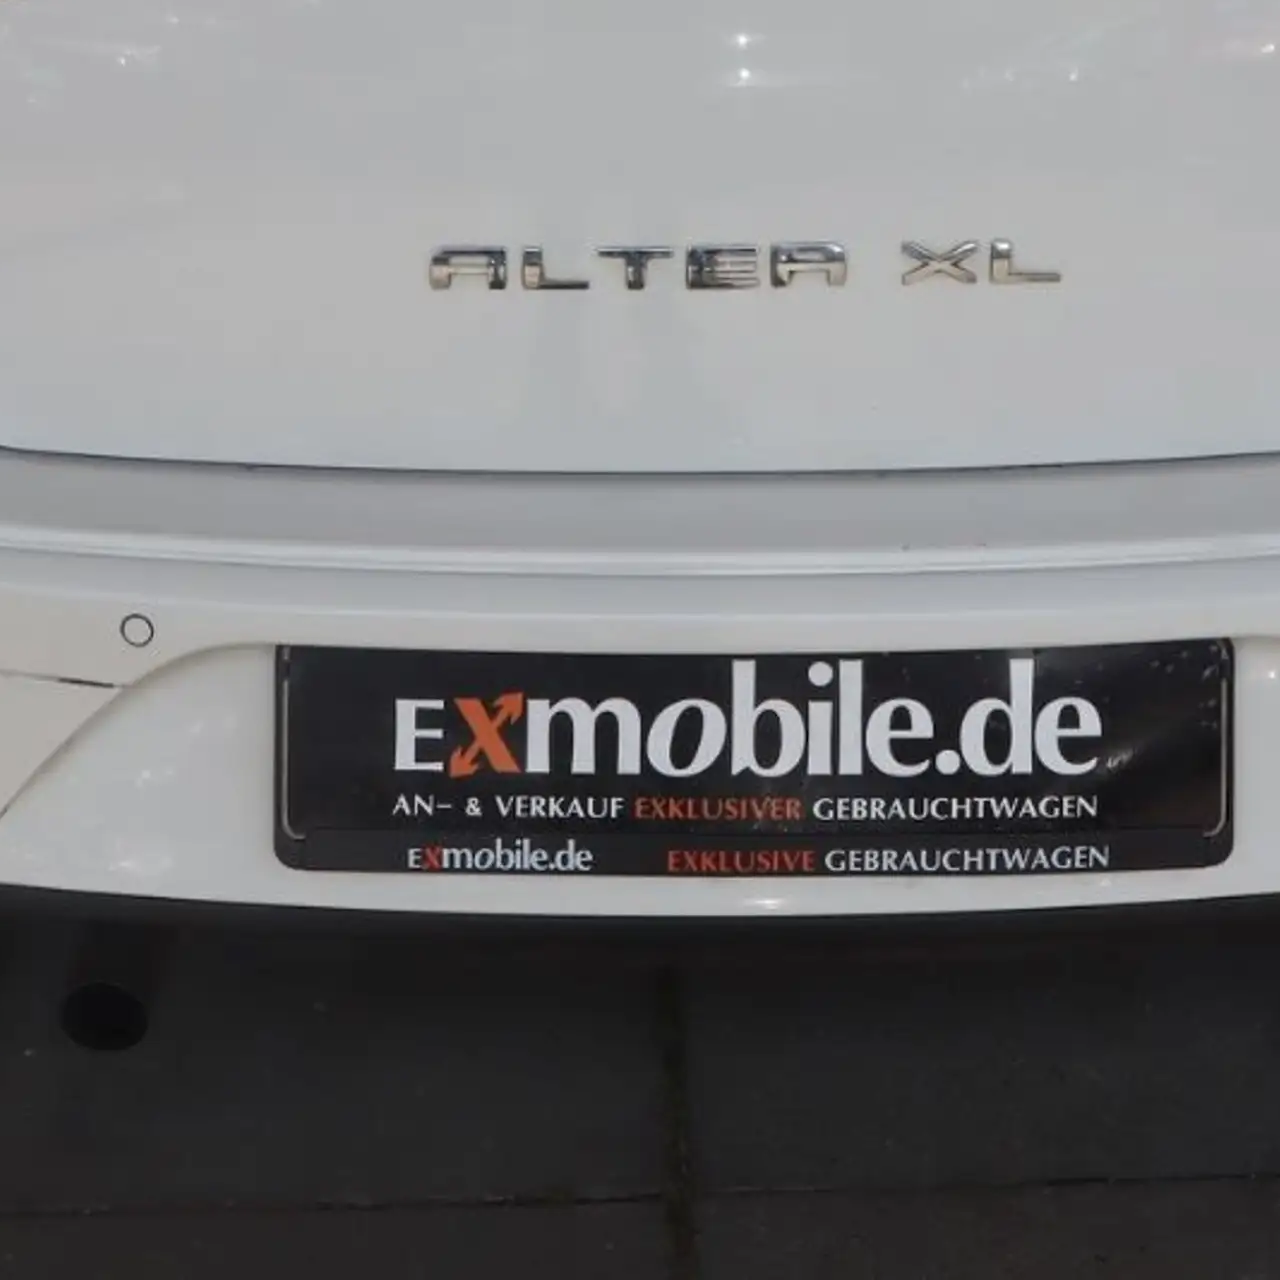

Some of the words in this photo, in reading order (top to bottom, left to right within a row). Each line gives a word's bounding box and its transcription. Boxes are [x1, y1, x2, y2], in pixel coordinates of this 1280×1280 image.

[428, 242, 848, 291] ALTEA
[901, 238, 1062, 287] XL
[465, 797, 483, 817] &
[495, 795, 625, 820] VERKAUF
[634, 796, 801, 821] EXKLUSIVER
[812, 795, 1098, 821] GEBRAUCHTWAGEN
[667, 849, 816, 873] EXKLUSIVE
[824, 844, 1111, 873] GEBRAUCHTWAGEN
